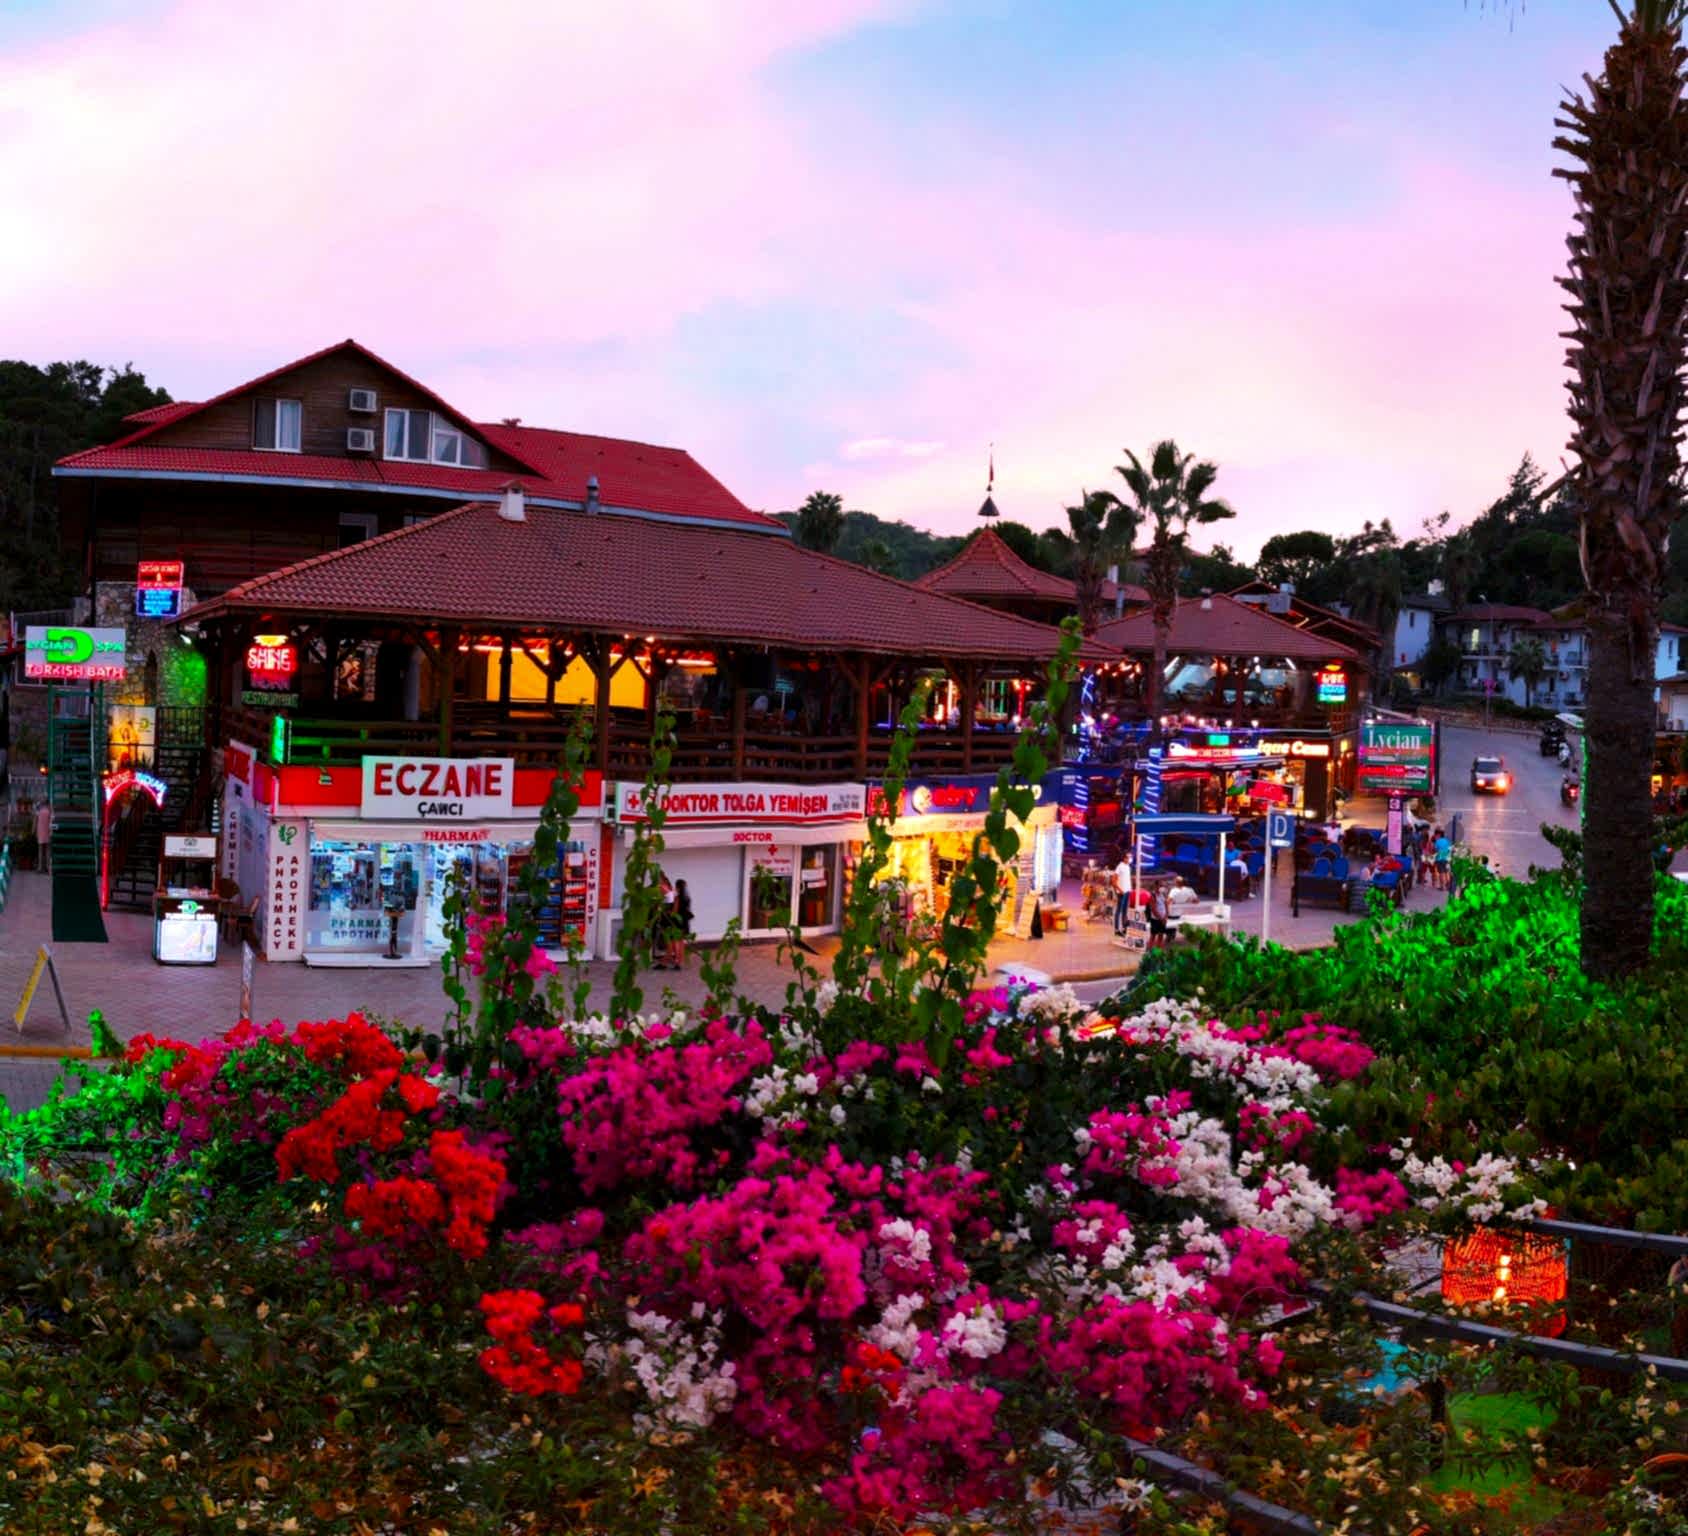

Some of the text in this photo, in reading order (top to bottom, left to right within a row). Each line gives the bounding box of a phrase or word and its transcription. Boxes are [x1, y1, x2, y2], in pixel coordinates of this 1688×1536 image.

[96, 641, 124, 652] SPA
[247, 647, 291, 671] SHINE
[26, 664, 124, 679] TURKISH BATH
[1369, 728, 1421, 750] Lycian
[373, 762, 503, 797] ECZANE
[661, 794, 719, 813] DOKTOR
[722, 793, 765, 812] TOLGA
[769, 791, 829, 815] YEMİŞEN
[733, 832, 773, 843] DOCTOR
[1274, 815, 1288, 838] D
[587, 848, 597, 925] CHEMIST
[273, 856, 284, 950] PHARMACY
[287, 856, 298, 950] APOTHEKE
[331, 918, 393, 929] PHARMAC
